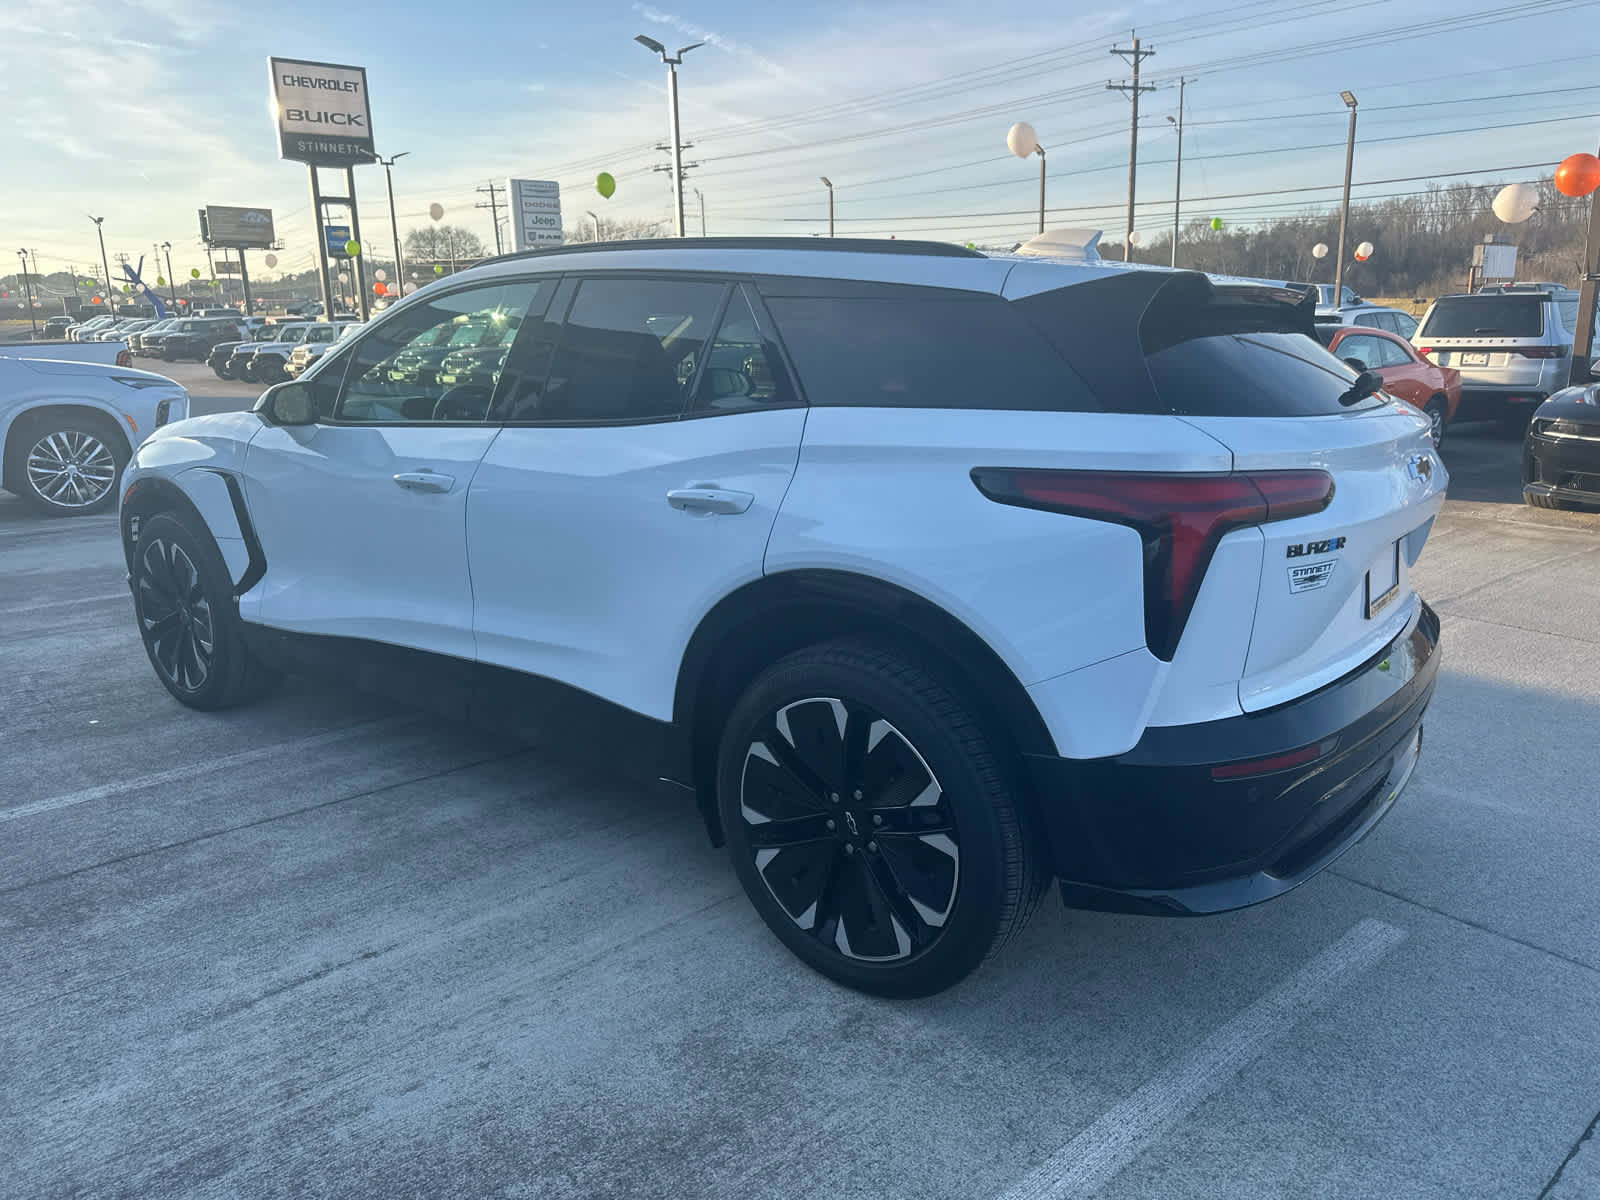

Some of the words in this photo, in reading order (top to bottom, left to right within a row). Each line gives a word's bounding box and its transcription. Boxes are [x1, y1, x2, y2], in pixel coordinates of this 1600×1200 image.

[282, 75, 360, 94] CHEVROLET
[286, 109, 365, 127] BUICK
[298, 141, 361, 155] STINNETT
[531, 215, 556, 227] Jeep
[1286, 536, 1346, 559] BLAZER
[1292, 563, 1332, 578] STINNETT
